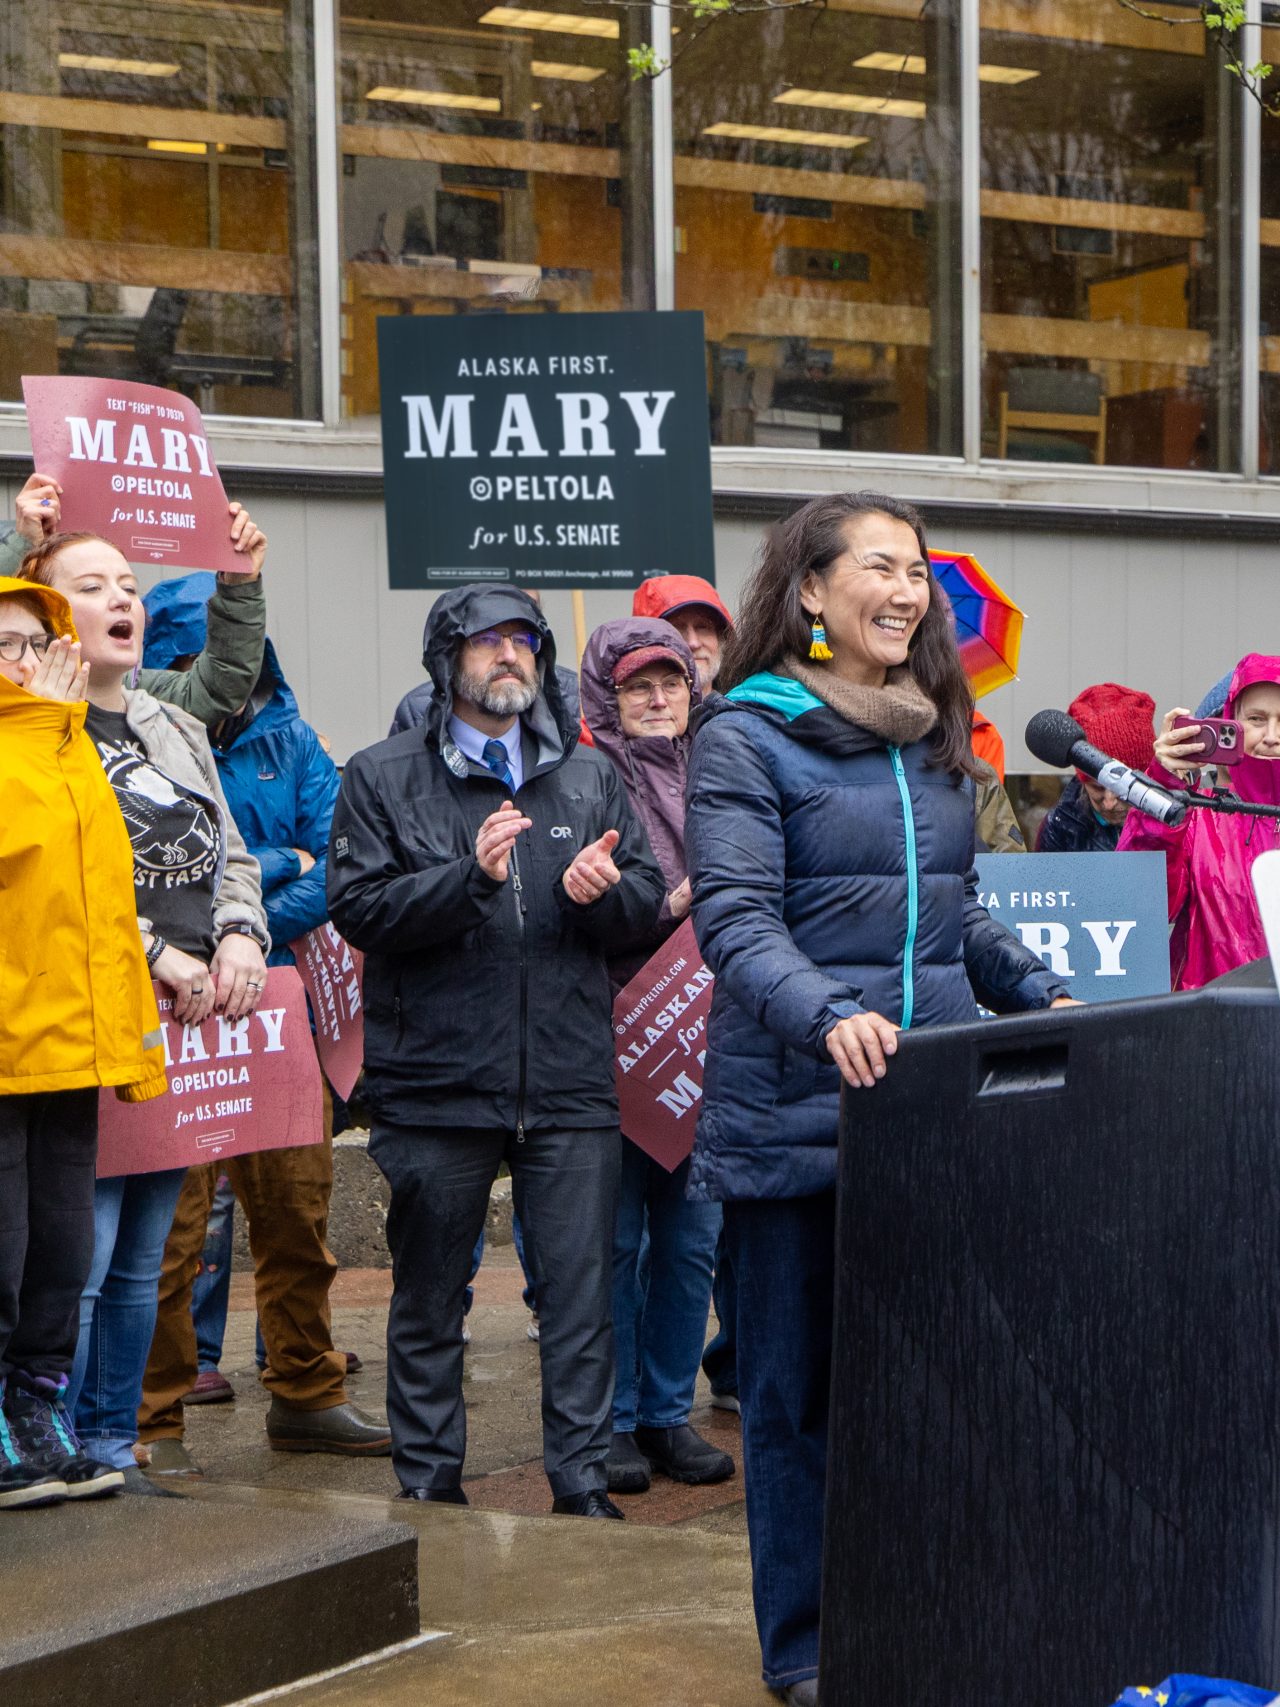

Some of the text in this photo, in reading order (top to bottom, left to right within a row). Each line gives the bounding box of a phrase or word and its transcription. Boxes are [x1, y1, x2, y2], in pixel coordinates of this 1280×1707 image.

[458, 355, 615, 377] ALASKA FIRST.
[107, 398, 185, 422] TEXT "FISH" TO 70379
[401, 391, 676, 458] MARY
[65, 416, 213, 477] MARY
[126, 479, 192, 500] PELTOLA
[496, 475, 615, 501] PELTOLA
[111, 507, 196, 529] for U.S. SENATE
[469, 524, 621, 549] for U.S. SENATE
[550, 826, 573, 839] OR
[1010, 891, 1076, 907] FIRST.
[327, 954, 344, 984] for
[158, 999, 173, 1010] TEX
[677, 1015, 705, 1056] for
[184, 1067, 250, 1093] PELTOLA
[175, 1097, 253, 1128] for U.S. SENATE
